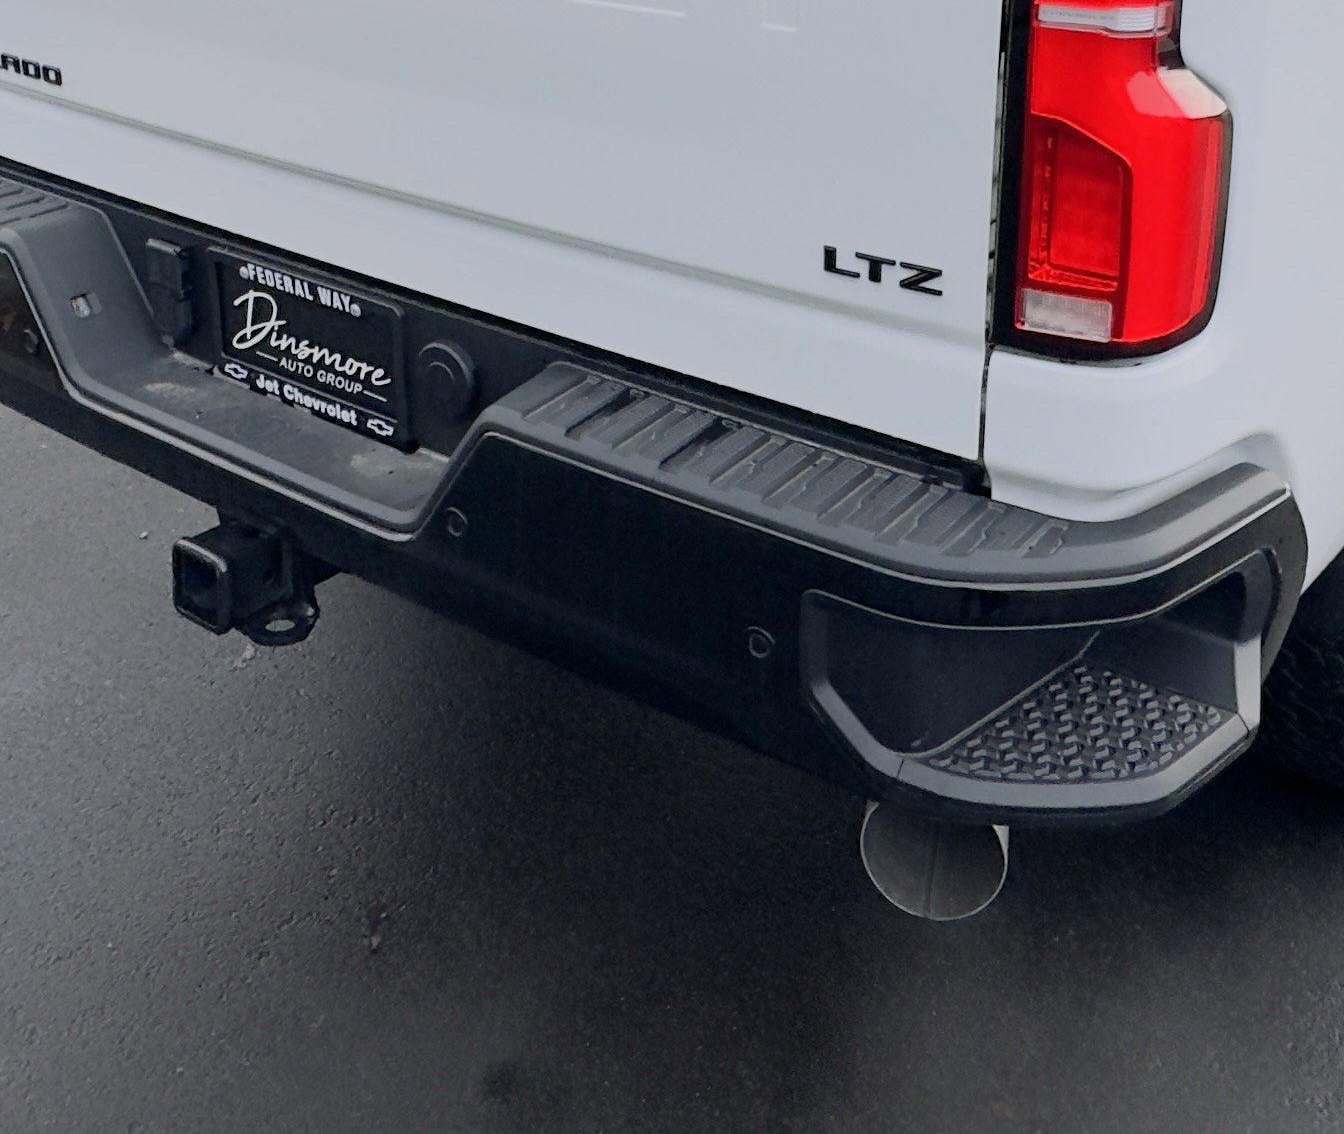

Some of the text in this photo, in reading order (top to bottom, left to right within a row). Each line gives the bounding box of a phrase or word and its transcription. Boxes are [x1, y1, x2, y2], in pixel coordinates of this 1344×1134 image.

[247, 262, 353, 314] FEDERAL WAY
[823, 244, 944, 297] LTZ
[232, 289, 392, 386] Dinsmore
[255, 373, 358, 426] Jet Chevrolet
[278, 356, 364, 395] AUTO GROUP
